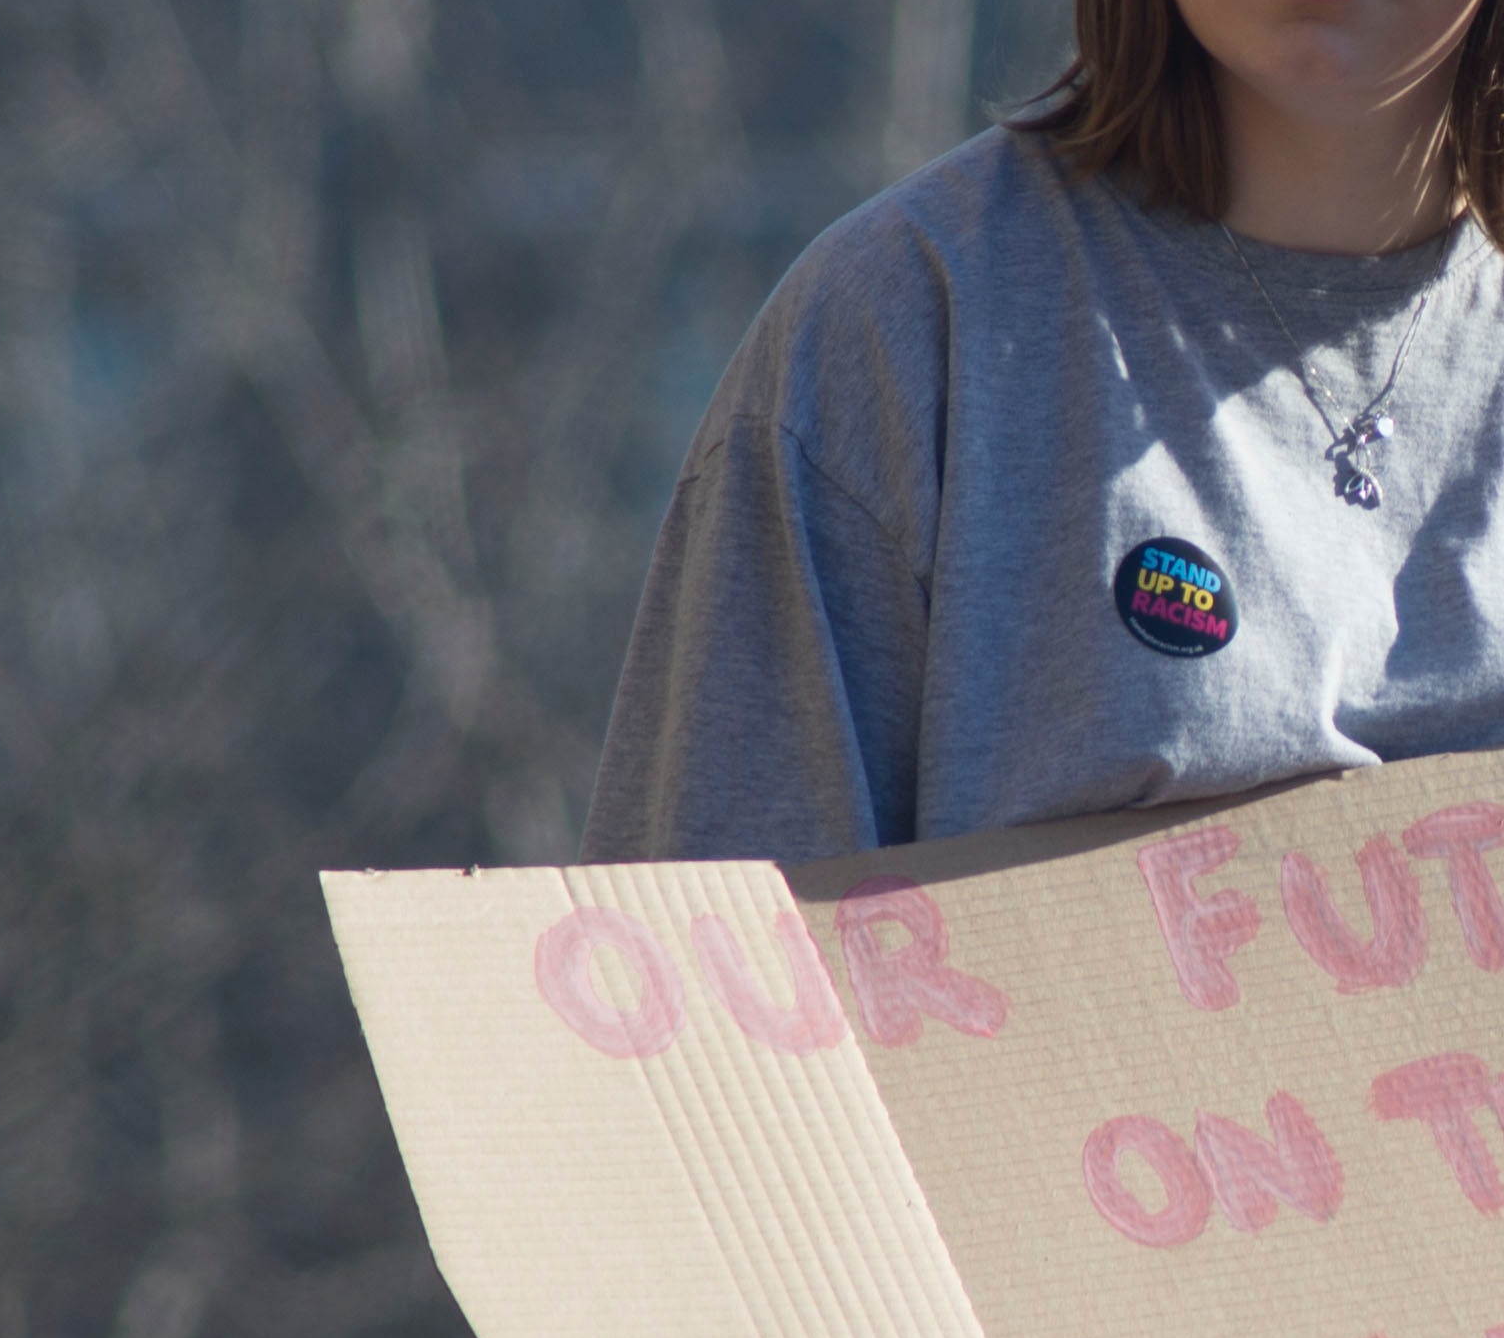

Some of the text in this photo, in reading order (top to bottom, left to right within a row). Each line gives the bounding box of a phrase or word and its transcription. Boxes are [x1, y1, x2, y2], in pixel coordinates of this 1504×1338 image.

[1137, 568, 1214, 612] UP TO
[1141, 547, 1221, 593] STAND
[1130, 590, 1229, 641] RACISM
[535, 874, 1012, 1059] OUR
[1083, 1088, 1344, 1248] ON
